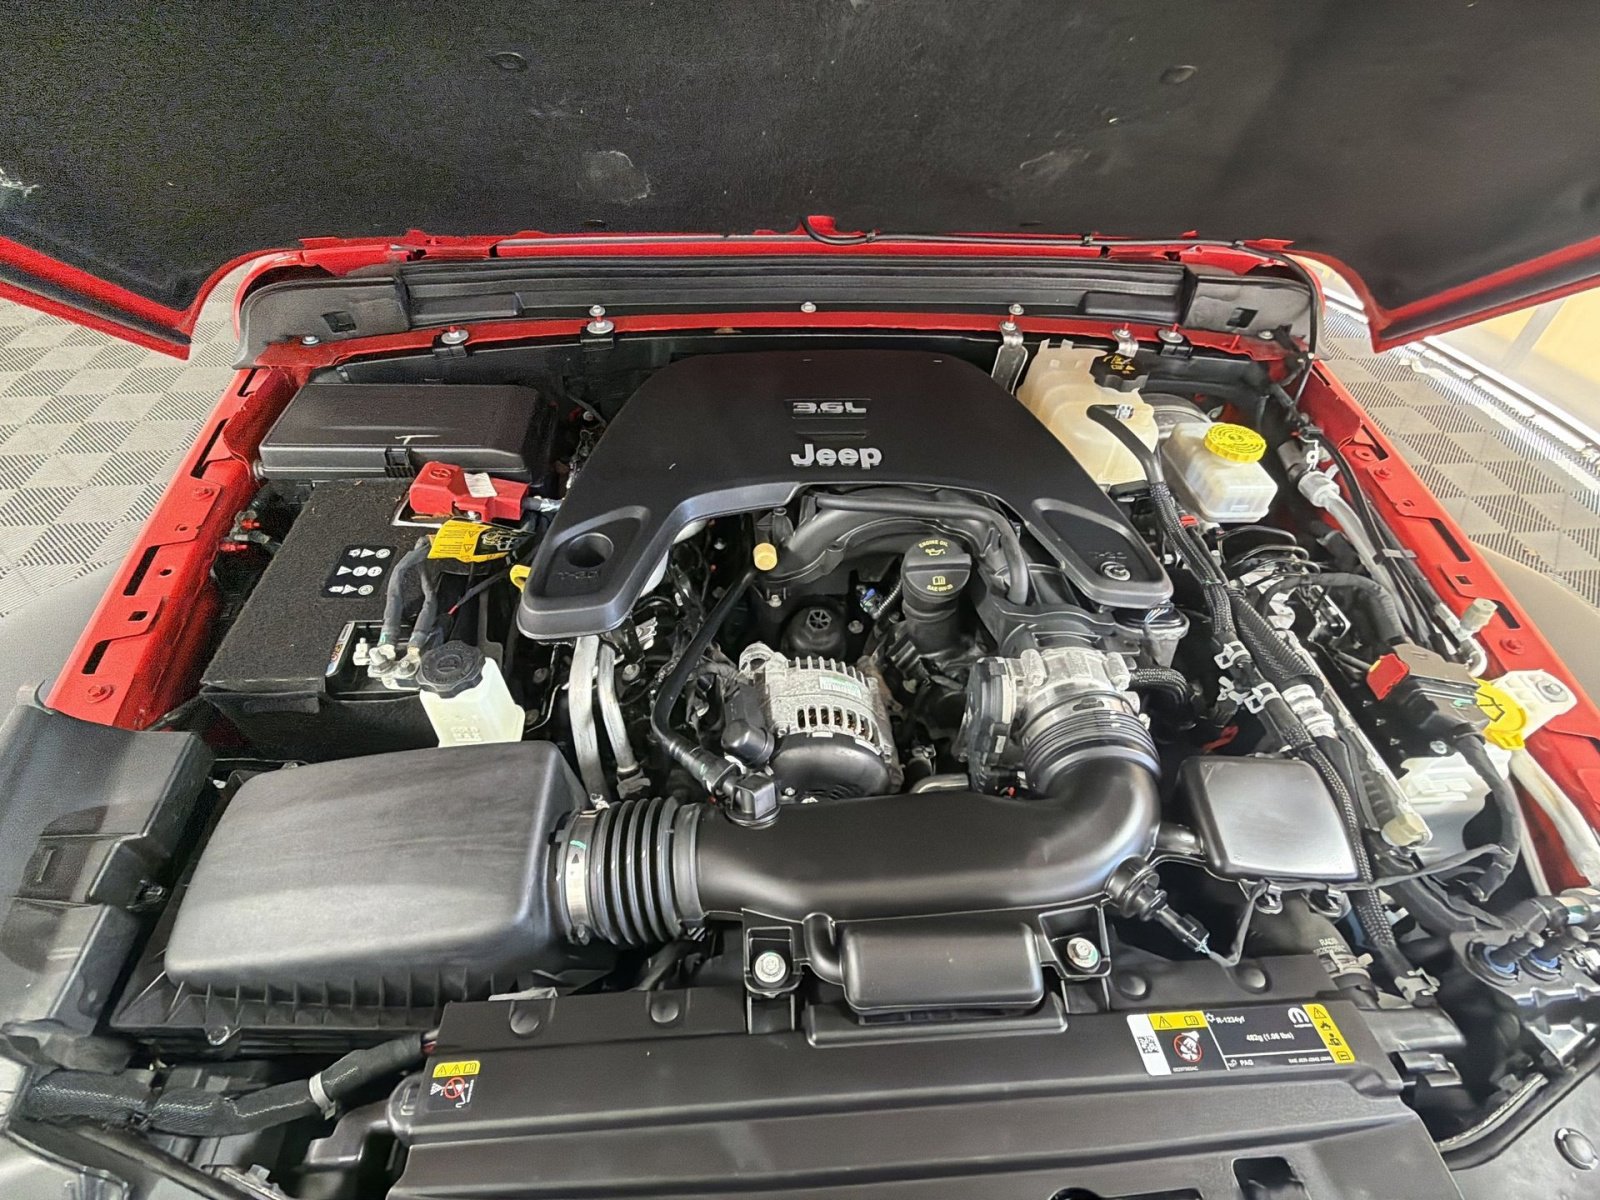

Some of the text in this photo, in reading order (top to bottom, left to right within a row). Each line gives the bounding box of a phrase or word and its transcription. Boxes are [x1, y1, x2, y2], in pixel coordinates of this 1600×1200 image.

[792, 401, 867, 414] 3.6L
[790, 443, 883, 470] Jeep
[918, 540, 939, 548] ENGINE
